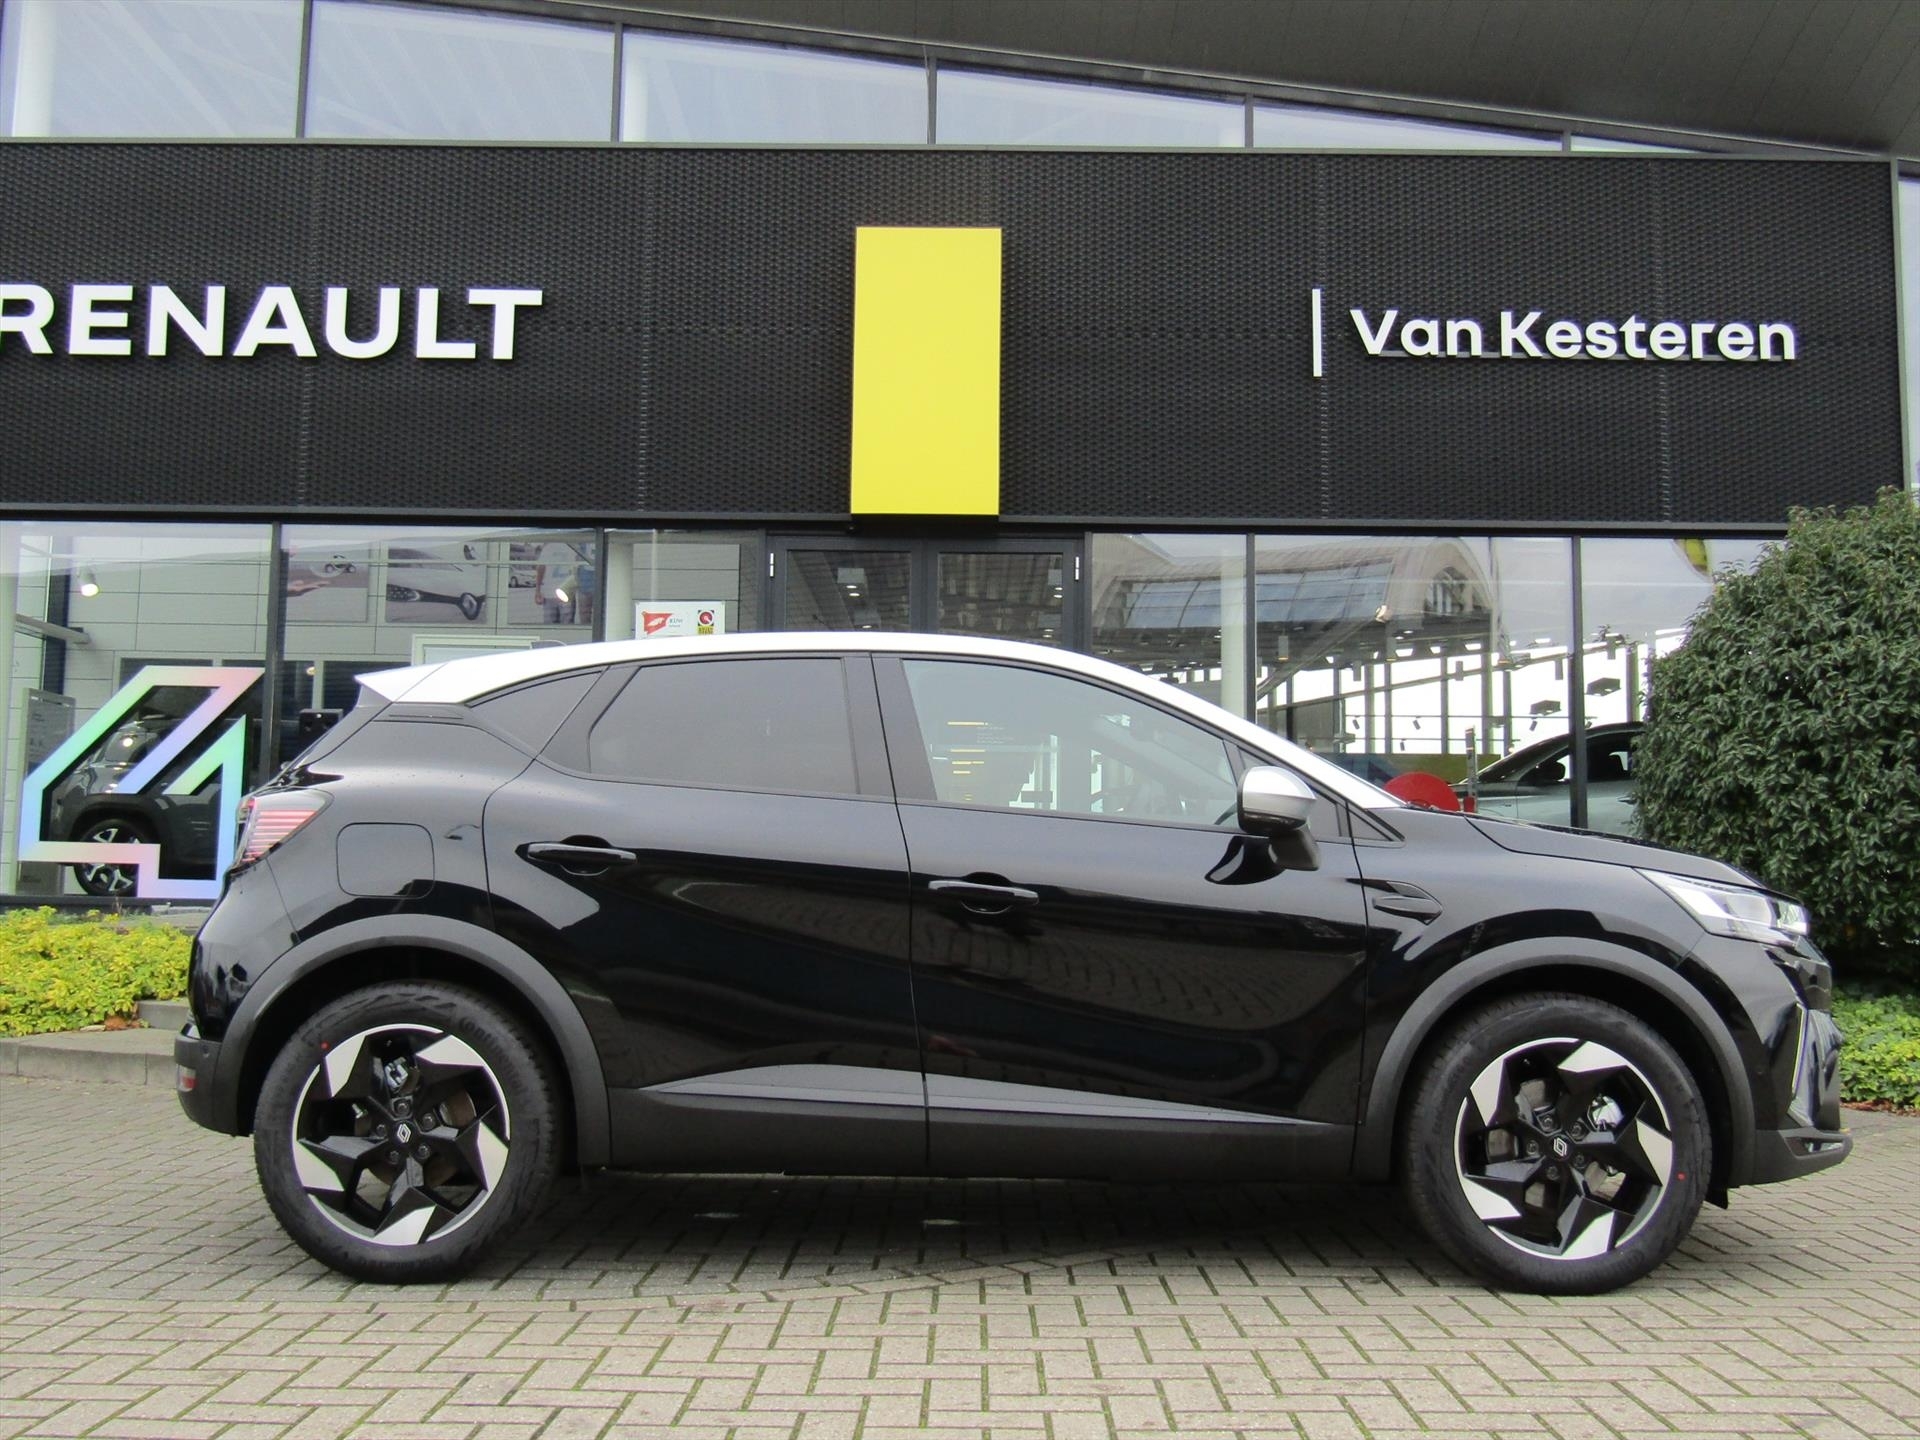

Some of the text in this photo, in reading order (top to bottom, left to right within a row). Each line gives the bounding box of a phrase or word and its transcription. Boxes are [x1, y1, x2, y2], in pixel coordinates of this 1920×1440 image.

[0, 283, 543, 360] RENAULT
[1349, 308, 1797, 361] Van Kesteren
